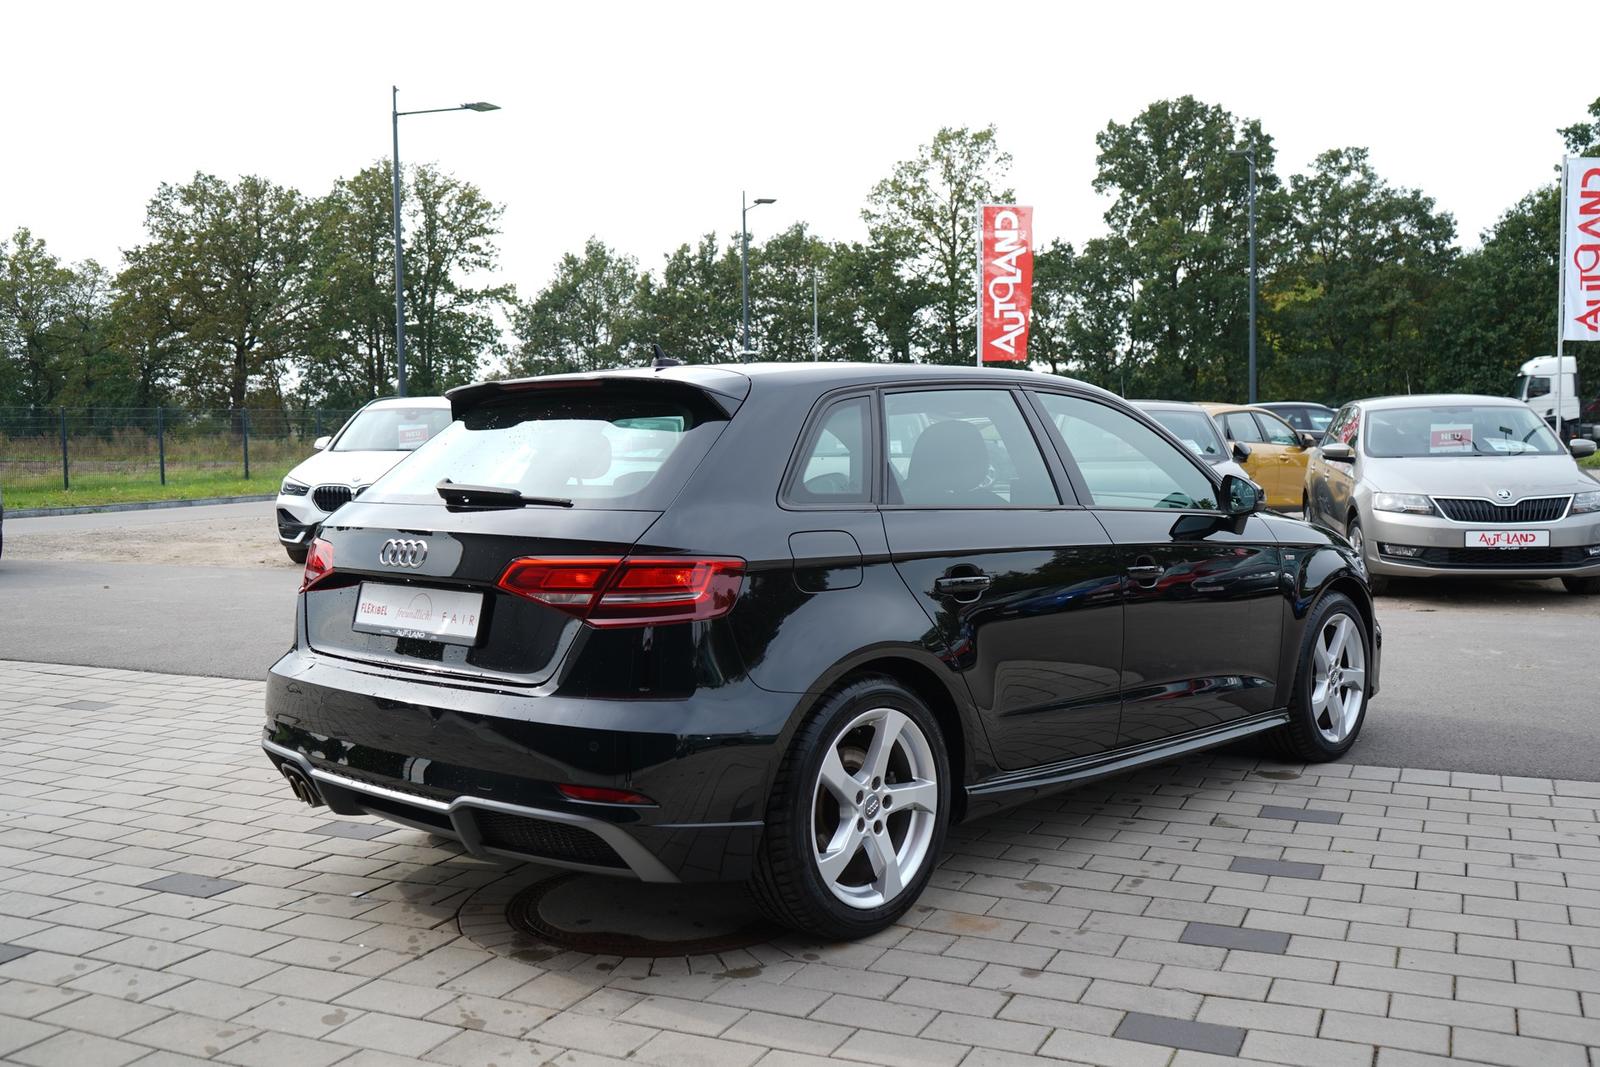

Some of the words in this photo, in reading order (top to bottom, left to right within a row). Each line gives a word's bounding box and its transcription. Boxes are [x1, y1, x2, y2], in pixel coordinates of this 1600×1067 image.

[989, 210, 1026, 354] AUTOLAND
[1479, 532, 1536, 545] AUTOLAND
[361, 602, 388, 616] FLEXIBEL
